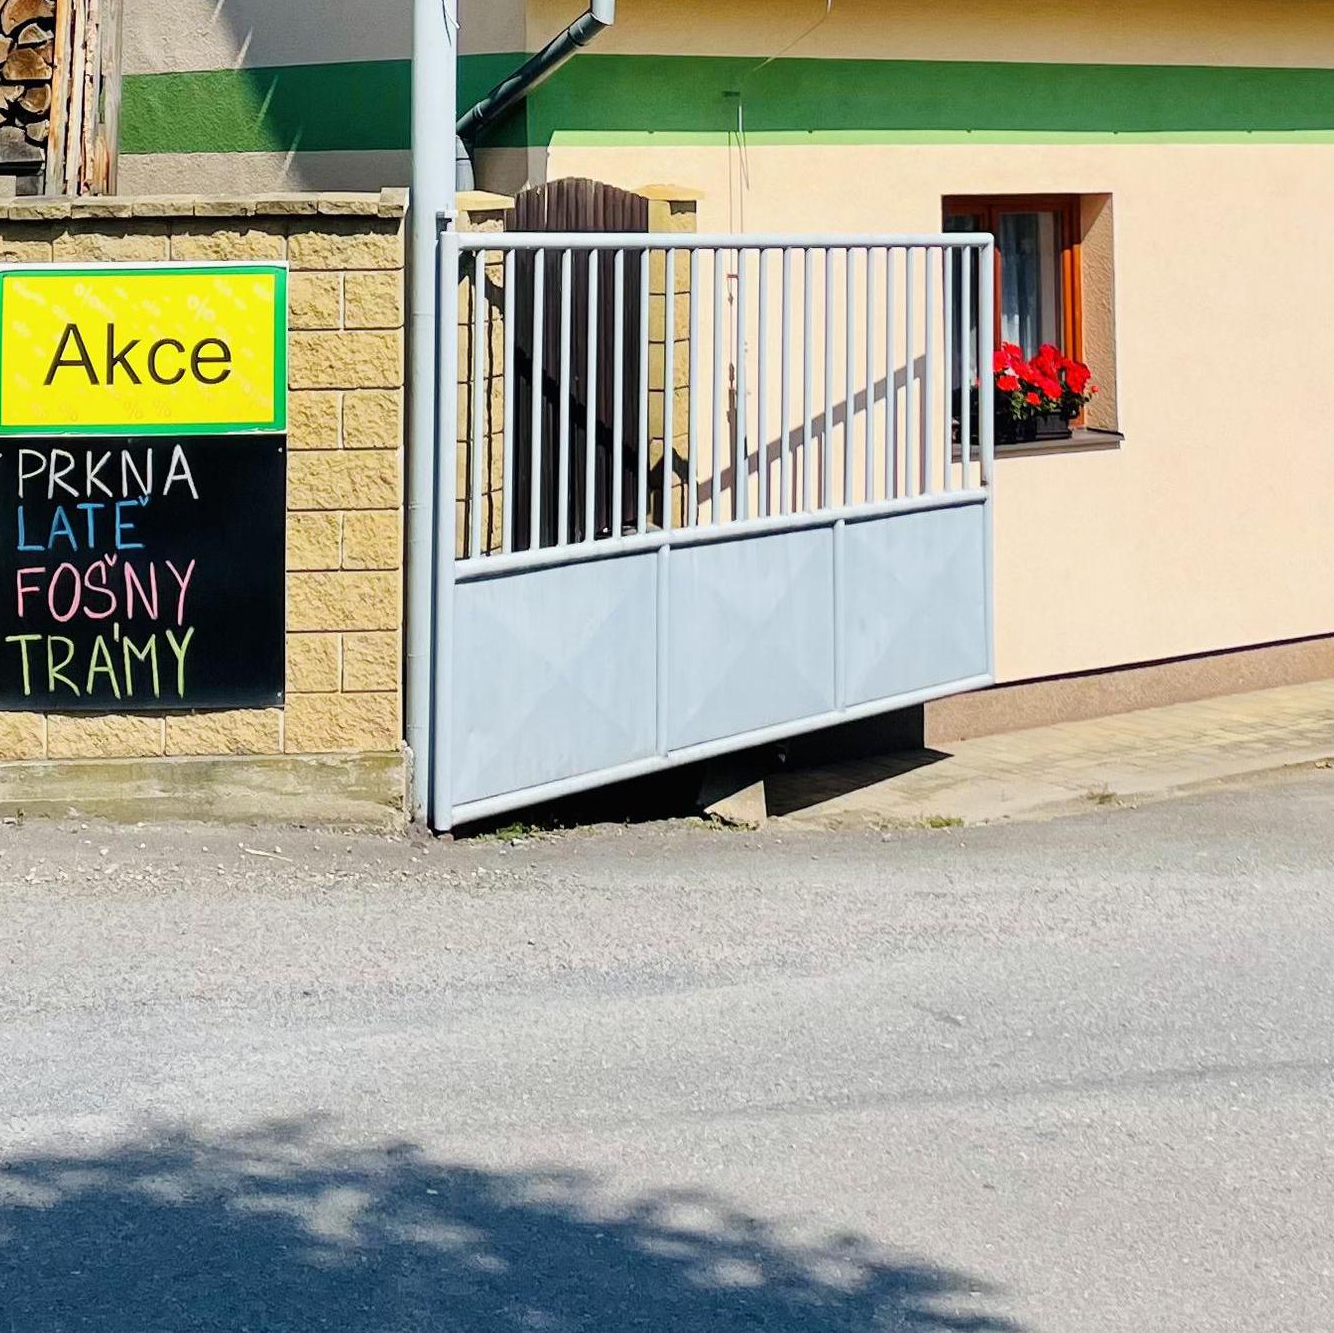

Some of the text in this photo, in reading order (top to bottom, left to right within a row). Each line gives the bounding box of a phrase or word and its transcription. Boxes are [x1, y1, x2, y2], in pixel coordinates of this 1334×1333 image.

[43, 322, 232, 386] Akce
[18, 444, 199, 499] PRKNA
[17, 495, 151, 551] LATĚ
[17, 554, 196, 626] FOŠNY
[5, 623, 195, 699] TRÁMY
